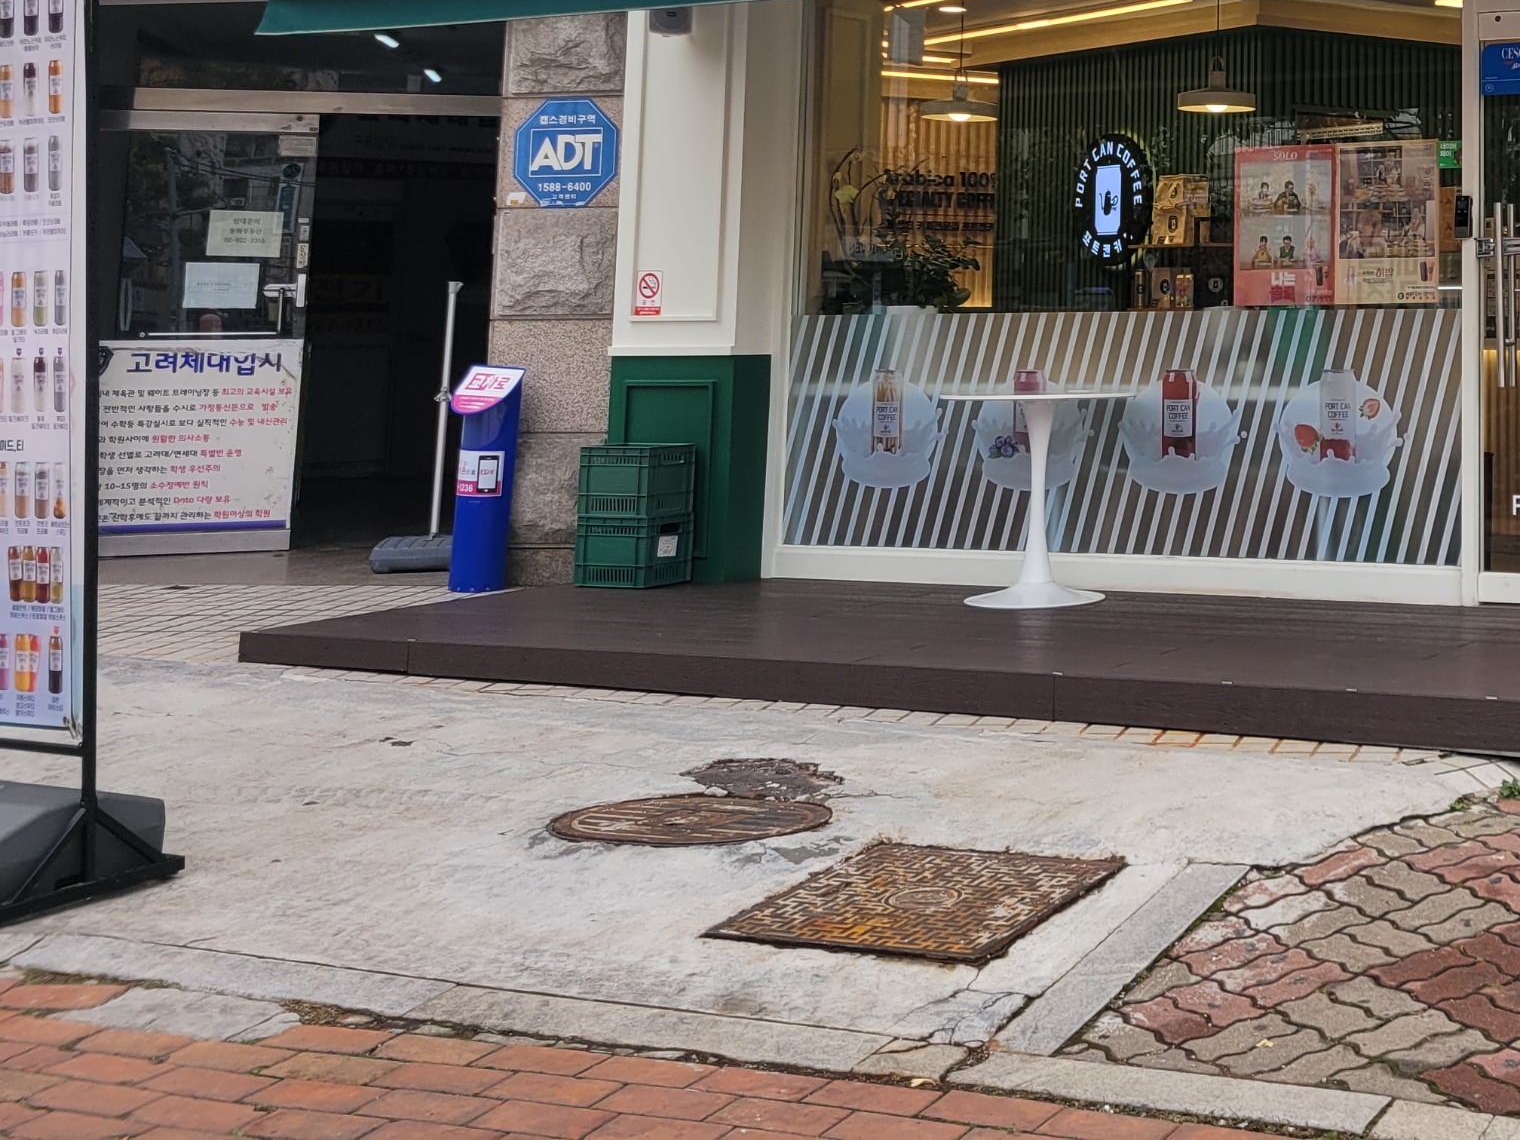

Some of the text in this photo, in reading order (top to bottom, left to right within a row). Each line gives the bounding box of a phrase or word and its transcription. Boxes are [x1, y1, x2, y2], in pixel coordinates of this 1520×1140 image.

[539, 115, 596, 125] 캡스경비구역
[530, 134, 602, 171] ADT
[1273, 151, 1298, 161] SOLO
[1075, 141, 1142, 208] PORT CAN COFFEE
[537, 182, 591, 192] 1588-6400
[127, 352, 283, 375] 고려체대입시
[173, 403, 196, 412] 수시로
[1166, 404, 1179, 412] PORT
[1325, 402, 1339, 410] PORT
[1168, 412, 1188, 420] COFFEE
[178, 419, 193, 427] 보다
